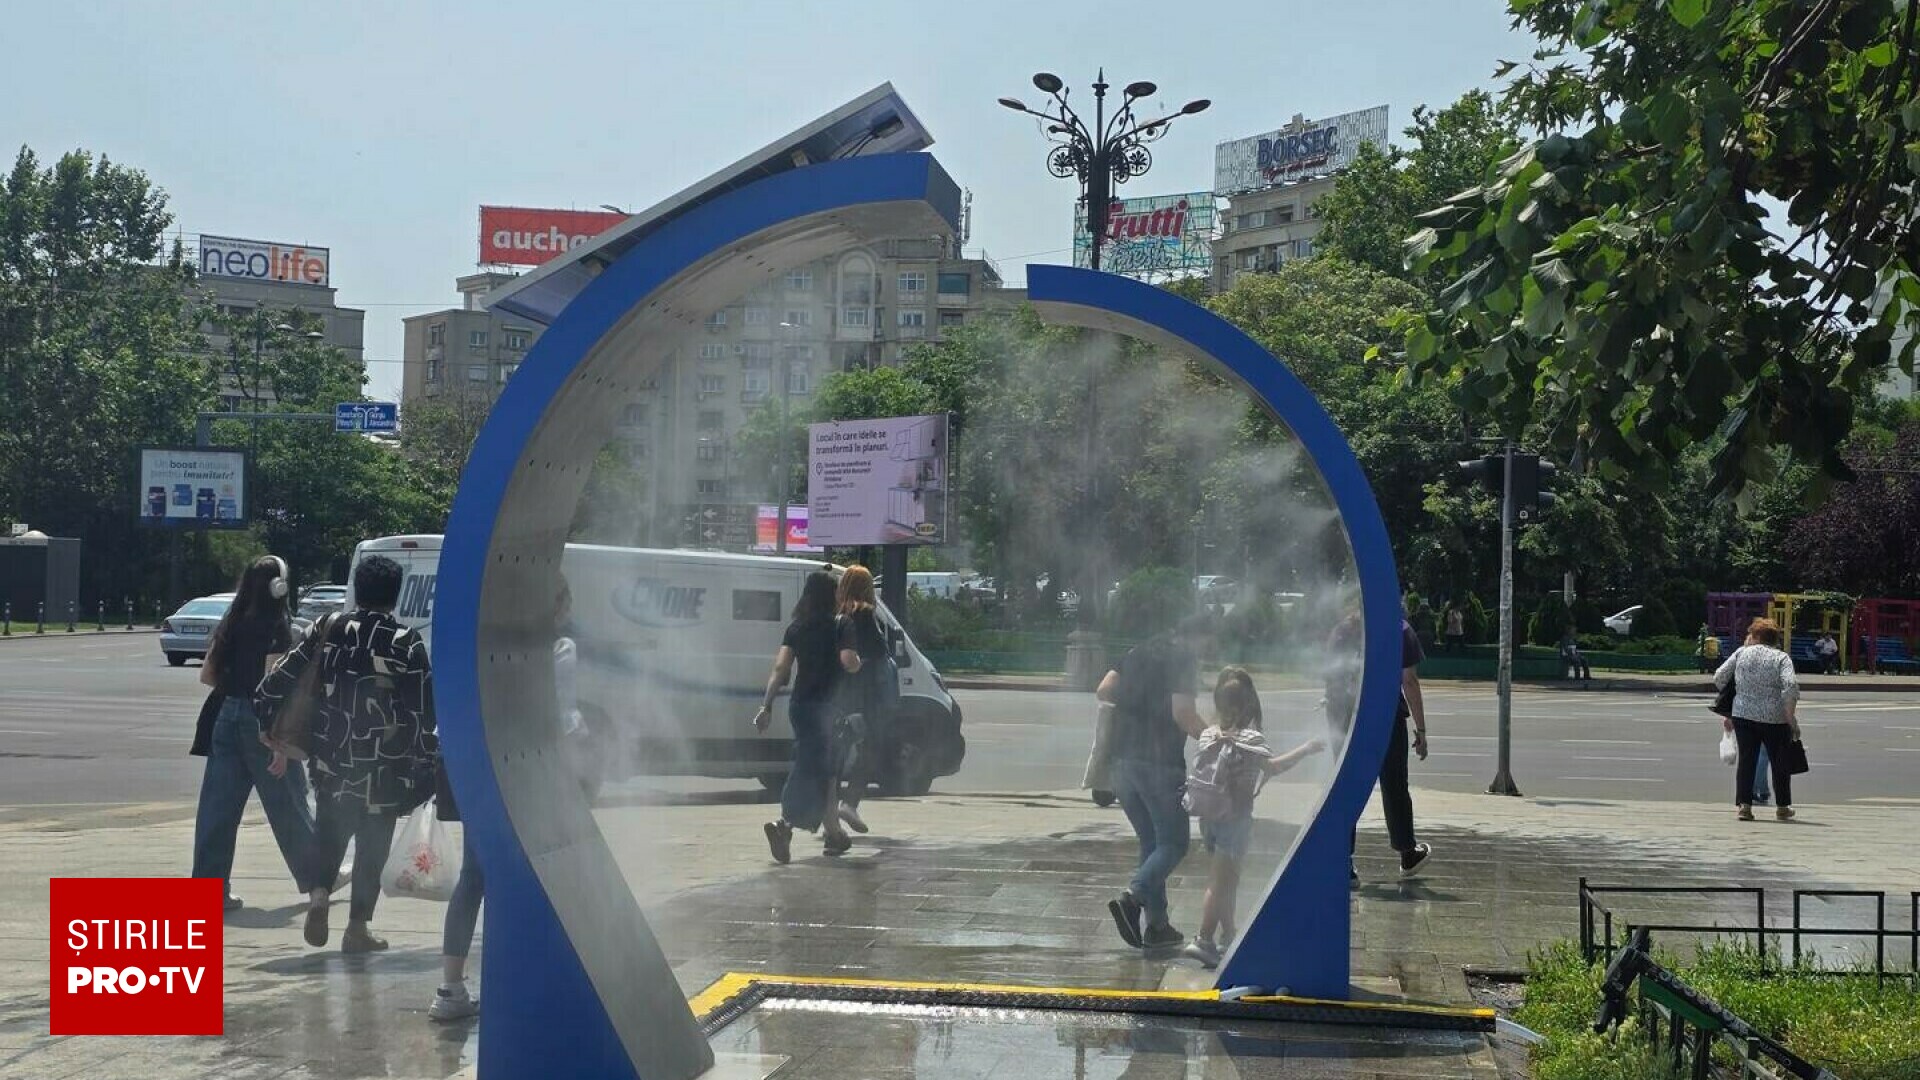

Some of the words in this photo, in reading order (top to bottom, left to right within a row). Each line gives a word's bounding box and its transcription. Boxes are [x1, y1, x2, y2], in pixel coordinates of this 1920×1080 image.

[1257, 126, 1340, 168] BORSEC
[493, 226, 598, 253] aucha
[203, 246, 325, 283] neolife
[843, 432, 857, 440] care
[878, 431, 886, 439] se
[170, 460, 197, 469] boost
